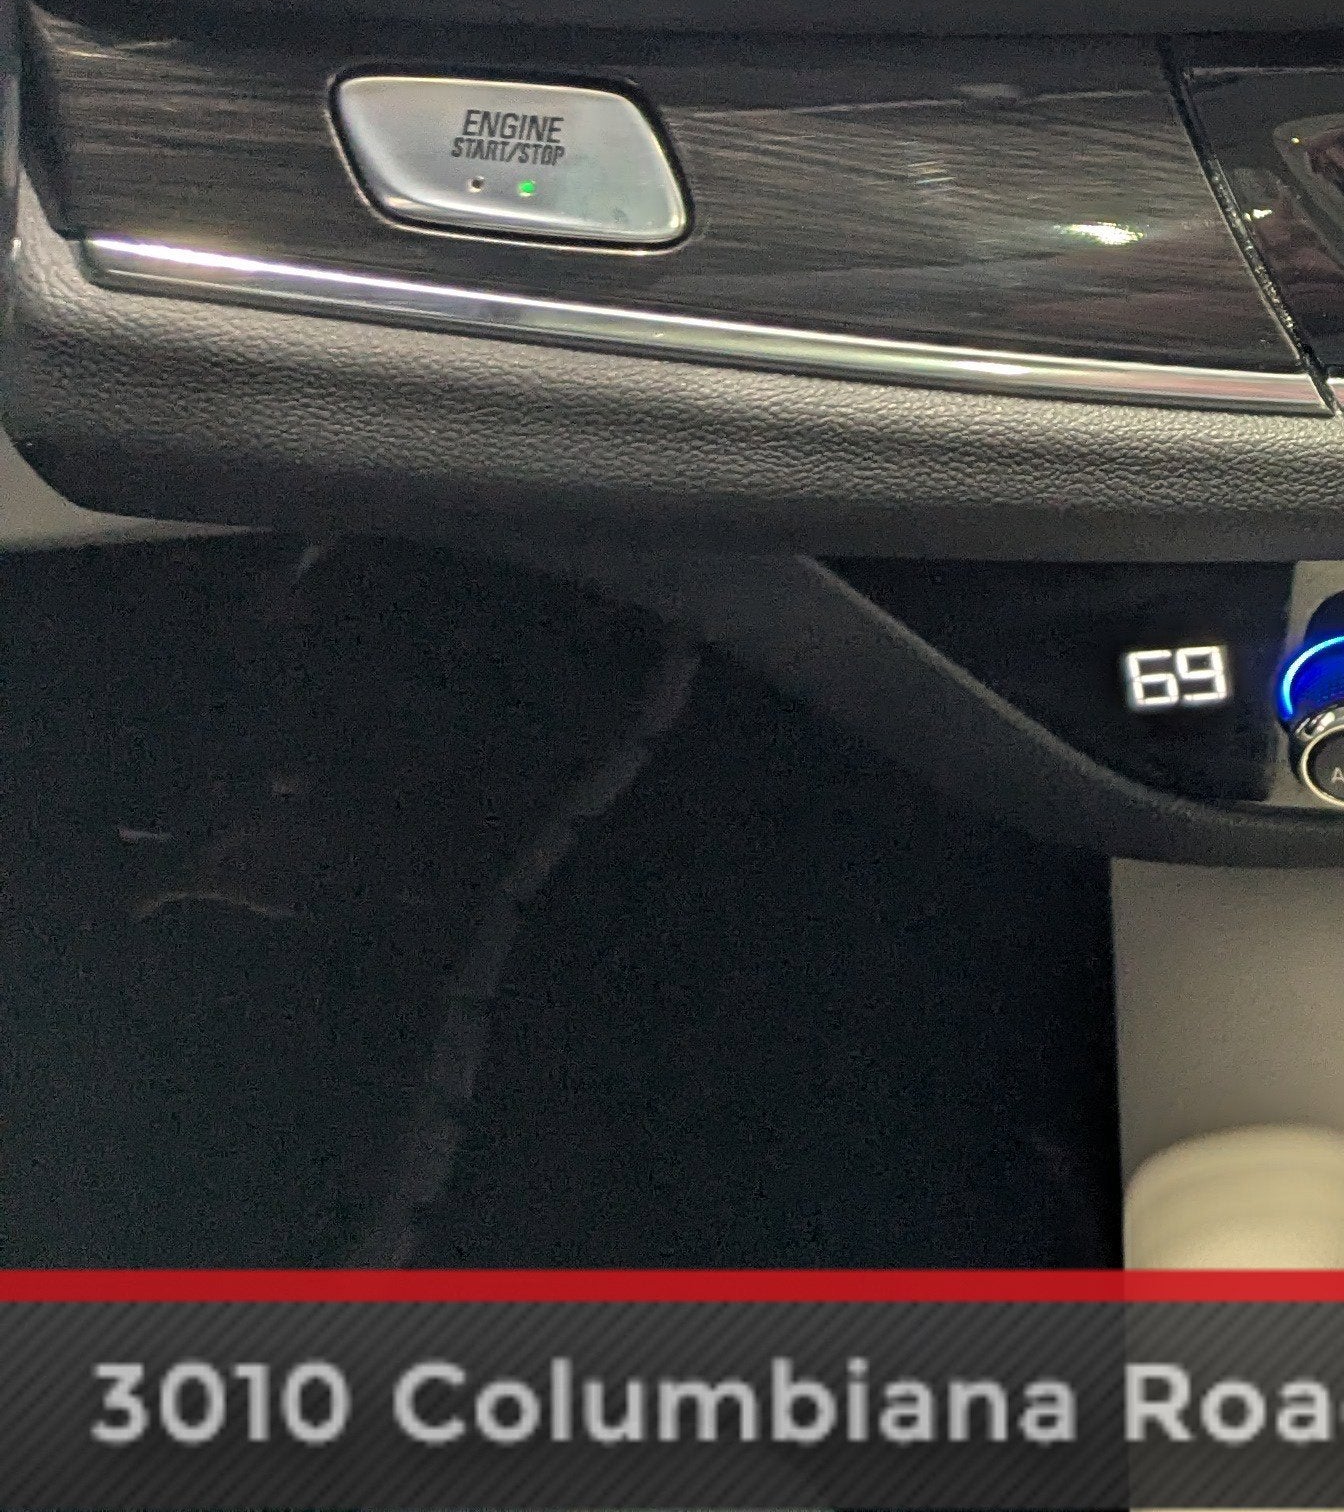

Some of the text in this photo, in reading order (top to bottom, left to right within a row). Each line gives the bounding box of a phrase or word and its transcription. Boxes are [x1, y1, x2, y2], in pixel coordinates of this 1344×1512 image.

[462, 108, 565, 144] ENGINE
[451, 137, 566, 167] START/STOP
[1124, 645, 1229, 707] 69
